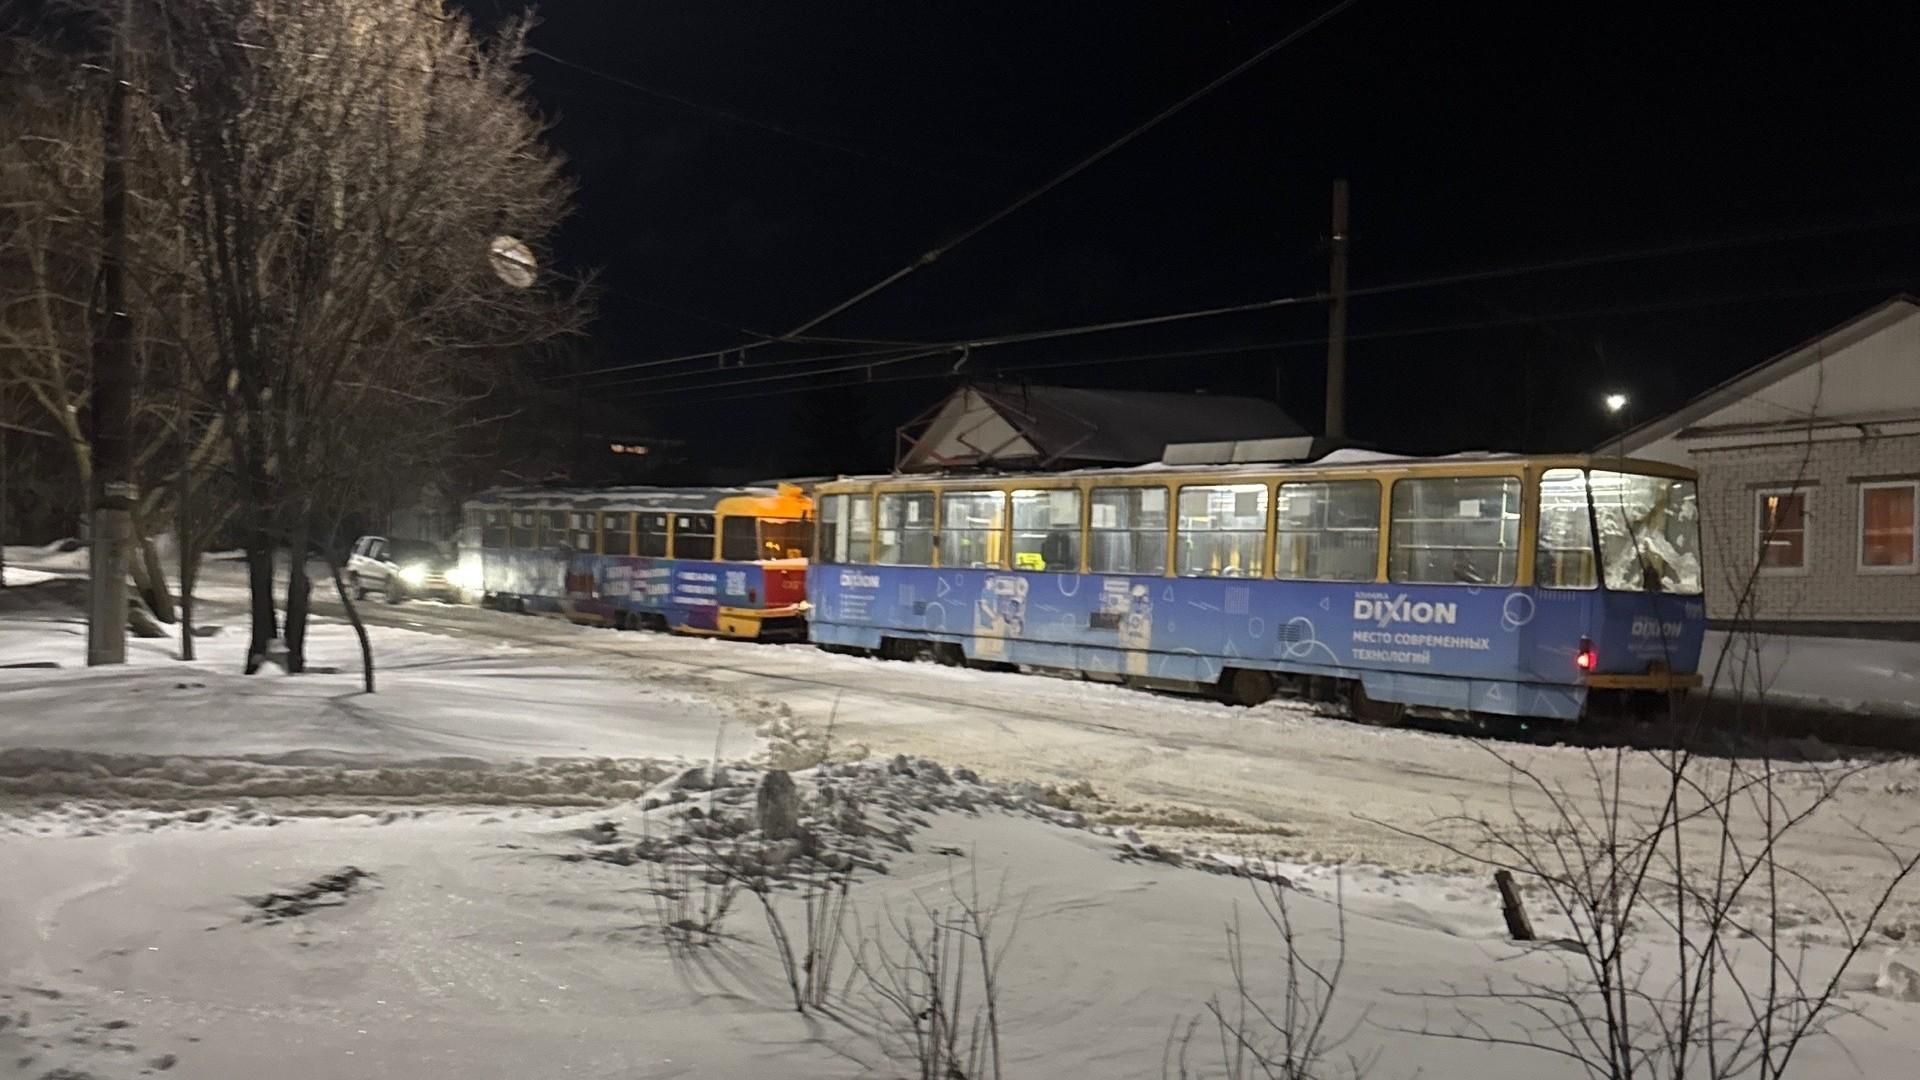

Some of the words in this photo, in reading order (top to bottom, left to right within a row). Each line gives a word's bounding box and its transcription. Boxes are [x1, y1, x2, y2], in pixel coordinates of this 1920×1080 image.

[1353, 594, 1457, 628] DIXION
[1352, 630, 1392, 644] МЕСТО
[1394, 632, 1490, 650] СОВРЕМЕННЫХ
[1352, 648, 1431, 665] ТЕХНОЛОГИЙ
